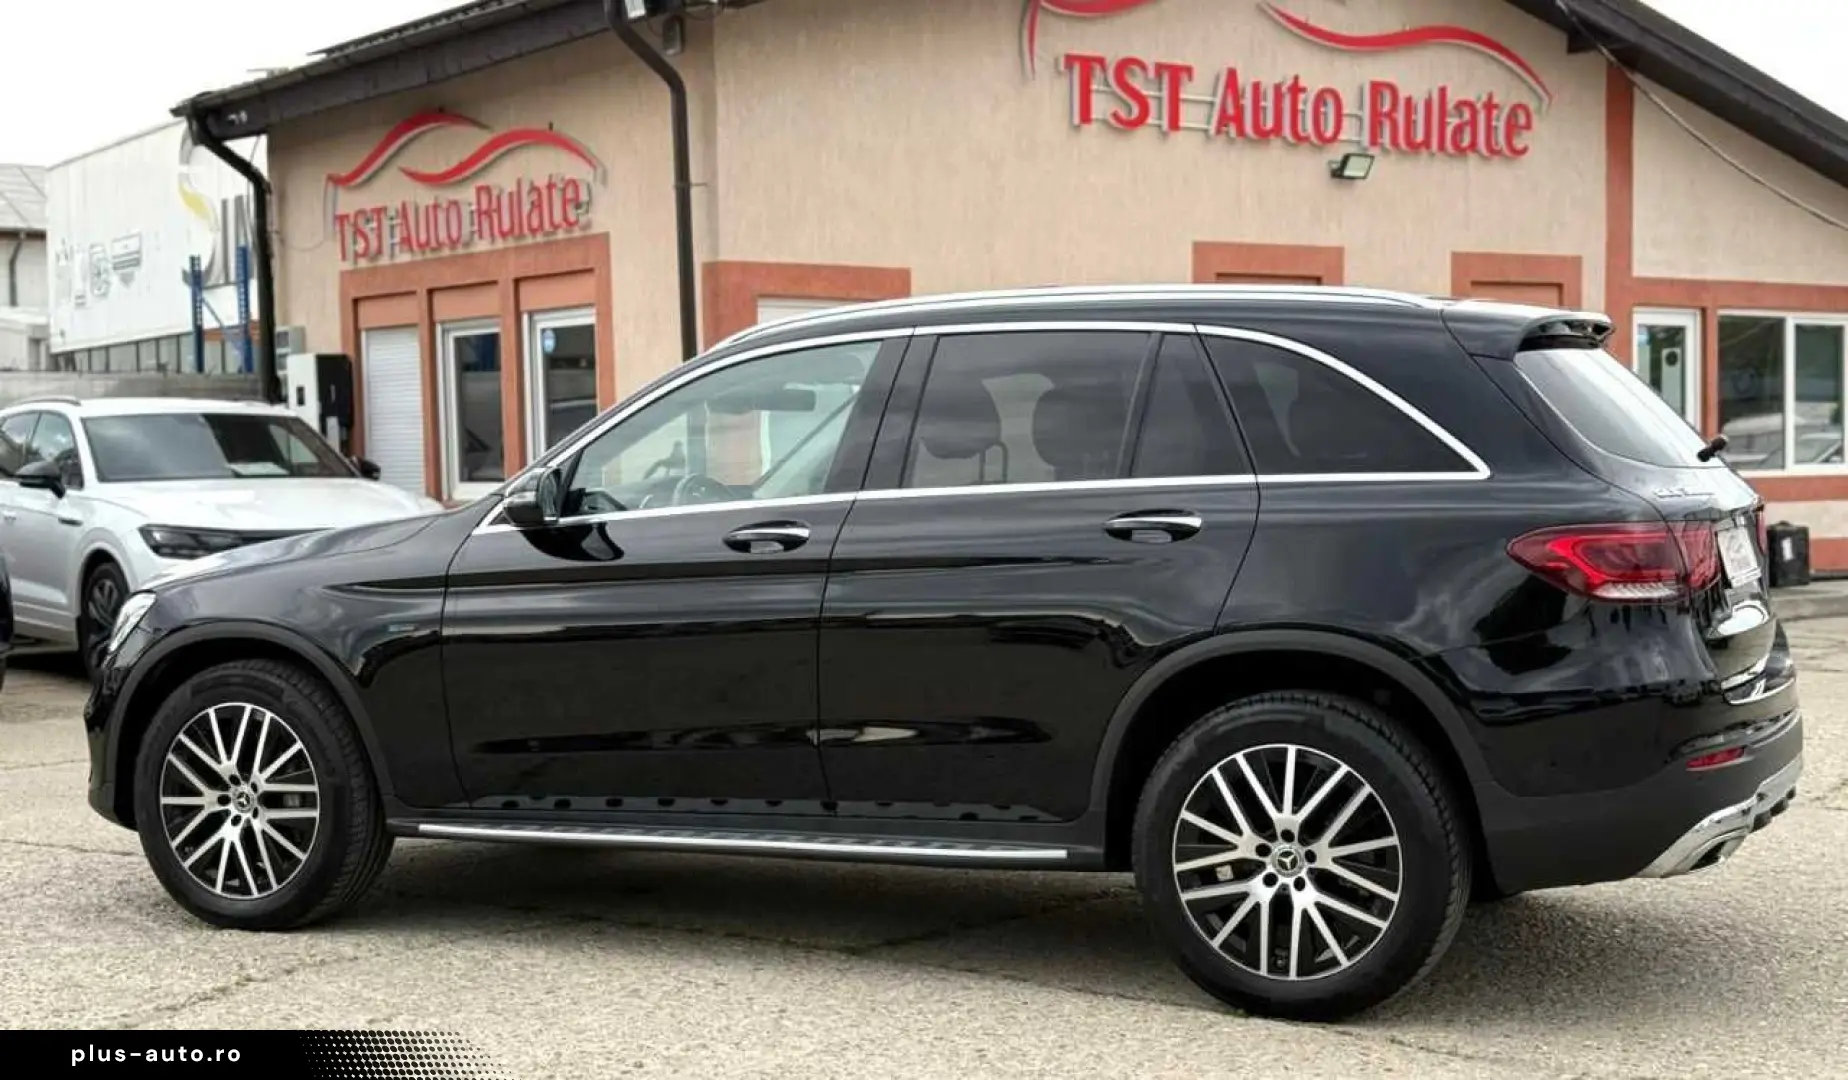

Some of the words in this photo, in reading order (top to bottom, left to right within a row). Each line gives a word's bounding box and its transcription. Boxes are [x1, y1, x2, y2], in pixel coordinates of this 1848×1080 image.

[1063, 53, 1193, 132] TST
[1214, 67, 1343, 145] Auto
[1366, 80, 1534, 158] Rulate
[335, 206, 388, 263] TST
[399, 198, 463, 252] Auto
[475, 177, 581, 241] Rulate
